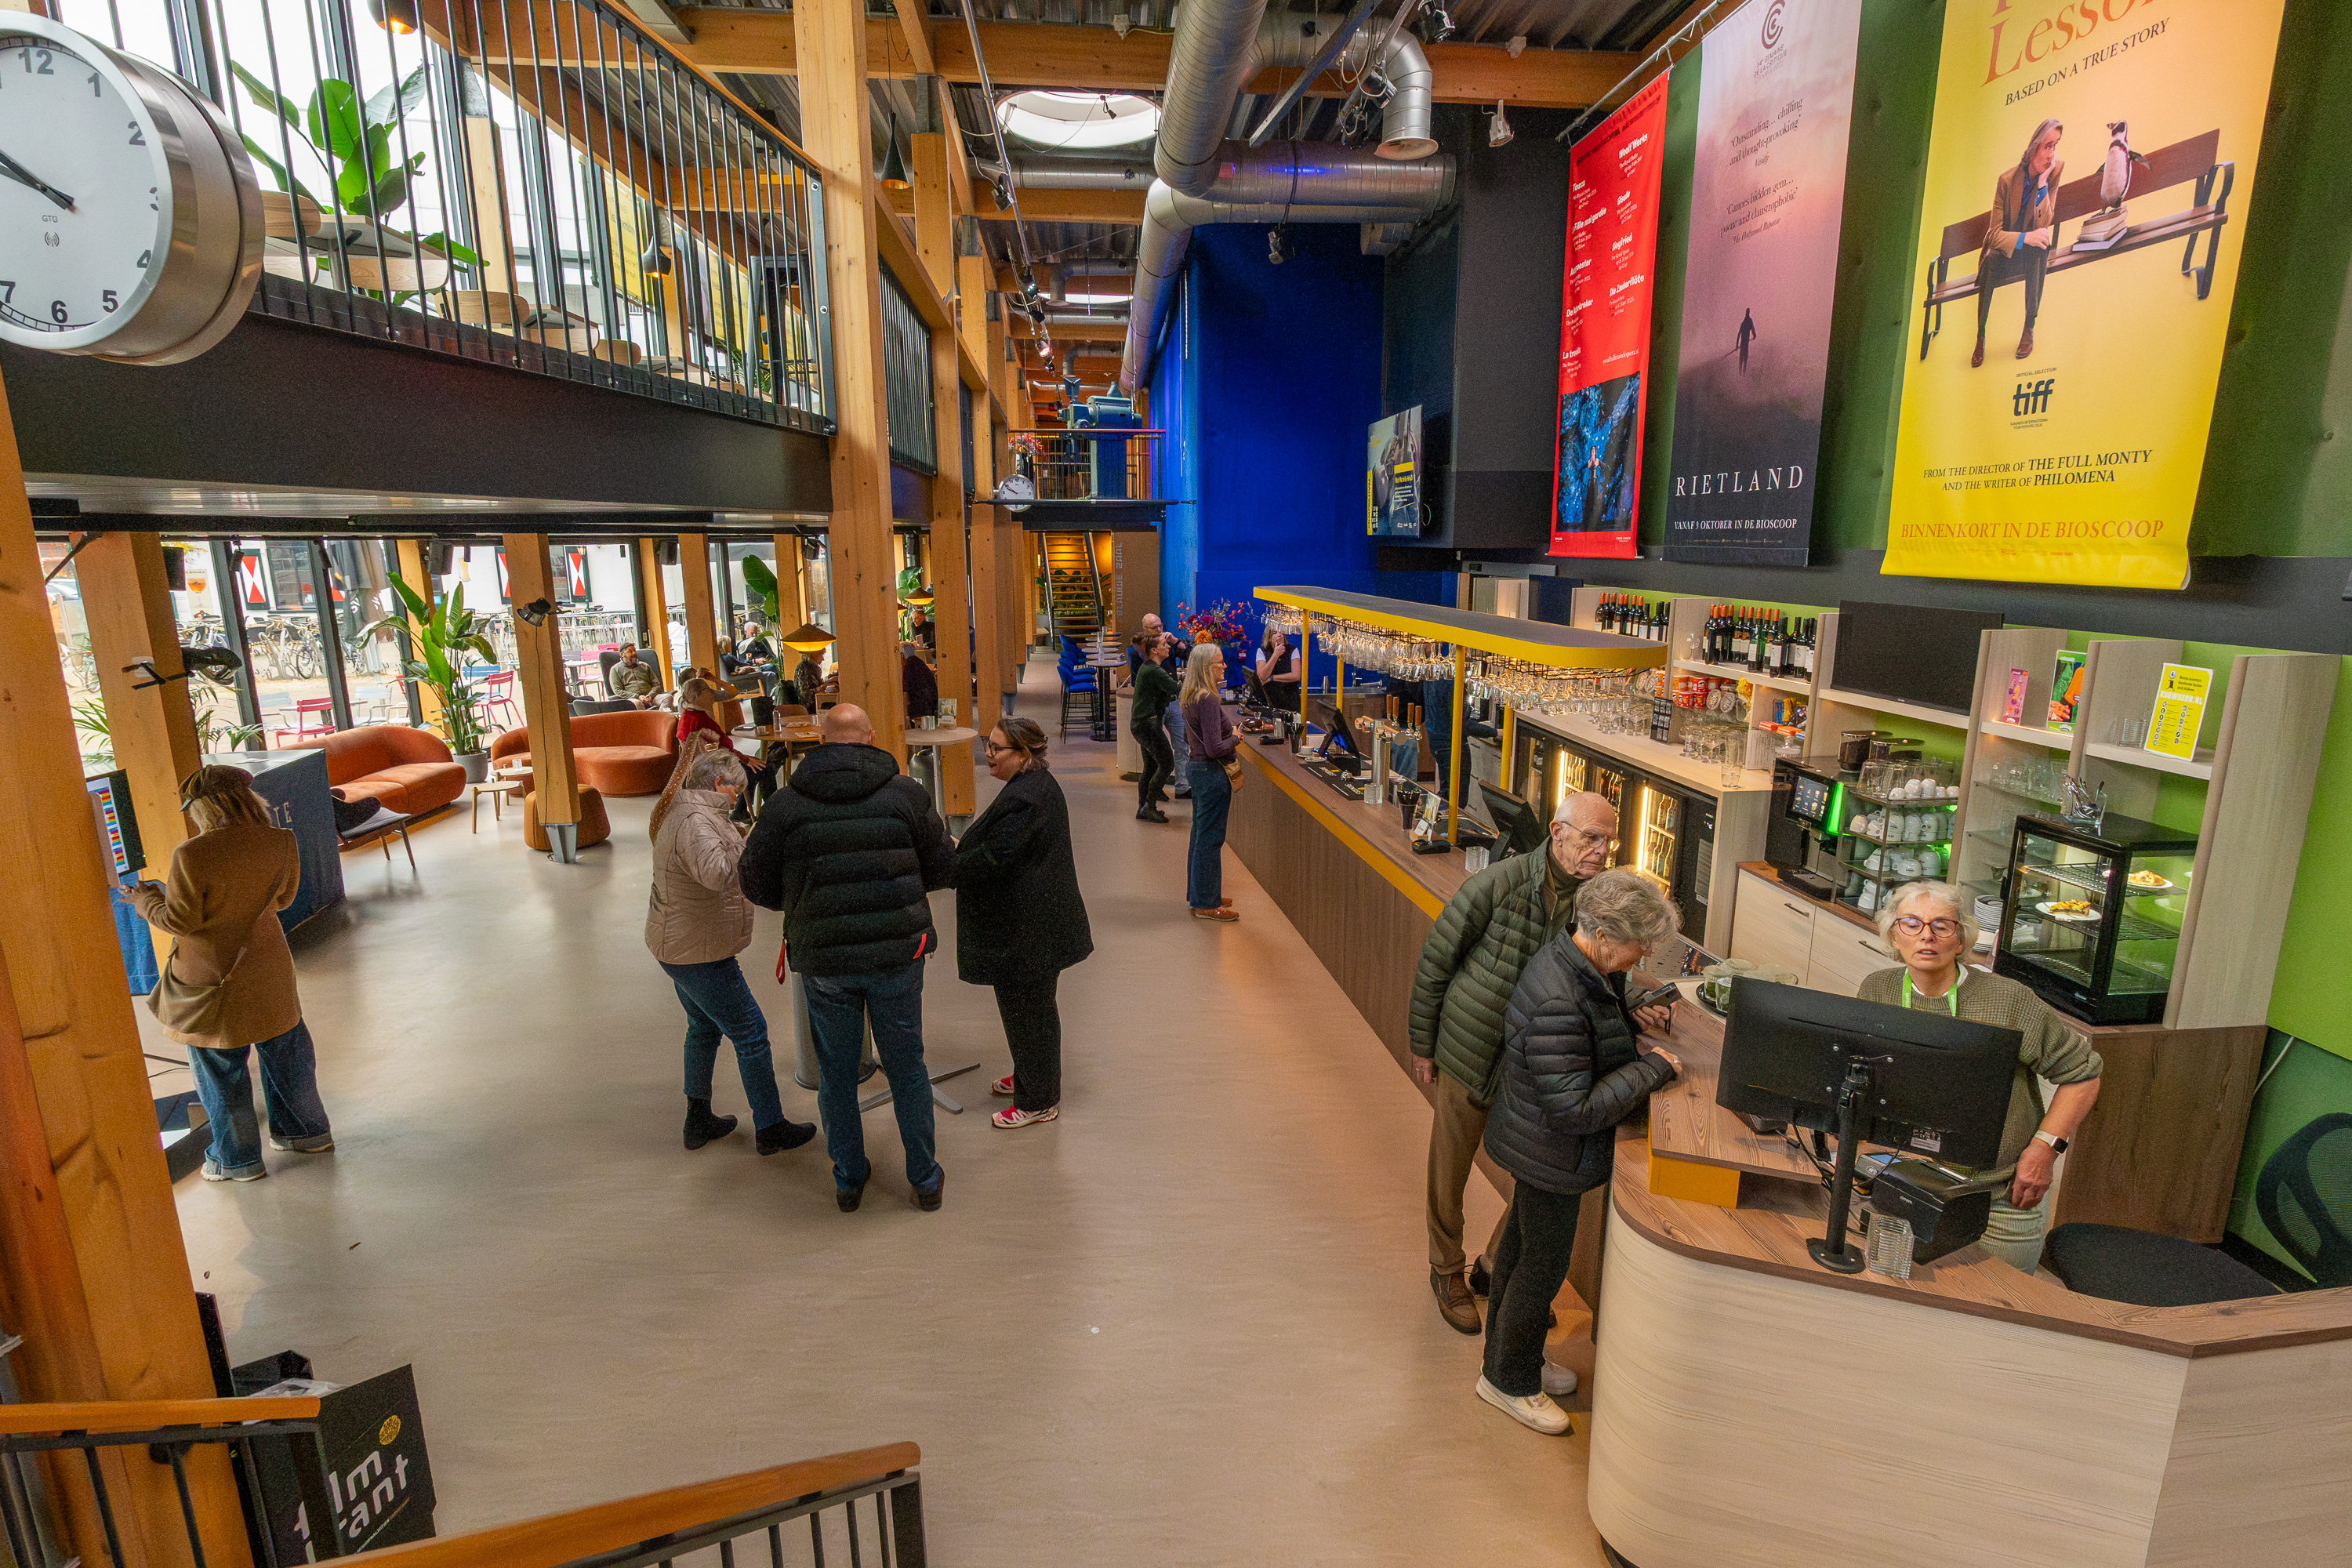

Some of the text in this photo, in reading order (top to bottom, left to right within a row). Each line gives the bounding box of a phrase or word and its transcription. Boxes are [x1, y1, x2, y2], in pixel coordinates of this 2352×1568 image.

[1980, 0, 2154, 87] Lesso
[18, 48, 54, 74] 12
[2005, 17, 2170, 106] BASED ON A TRUE STORY
[88, 73, 100, 97] 1
[1778, 99, 1803, 120] chilling
[128, 121, 146, 147] 2
[1619, 133, 1648, 159] Woolf Works
[1730, 150, 1740, 166] and
[1573, 180, 1585, 192] Tosca
[1750, 187, 1771, 204] hidden
[1617, 191, 1631, 205] Giselle
[1738, 211, 1750, 226] and
[1612, 232, 1632, 251] Siegfried
[136, 249, 152, 268] 4
[0, 281, 16, 304] 7
[1617, 274, 1645, 293] Zauberflöte
[51, 299, 67, 323] 6
[102, 289, 119, 314] 5
[1566, 309, 1573, 318] De
[2013, 379, 2055, 416] tiff
[1923, 449, 2153, 478] FROM THE DIRECTOR OF THE FULL MONTY
[1675, 466, 1803, 495] RIETLAND
[1941, 470, 2115, 491] AND THE WRITER OF PHILOMENA
[1675, 521, 1694, 530] VANAF
[1700, 520, 1733, 530] OKTOBER
[1734, 520, 1743, 529] IN
[1744, 519, 1755, 528] DE
[1756, 518, 1797, 528] BIOSCOOP
[1900, 520, 2164, 538] BINNENKORT IN DE BIOSCOOP
